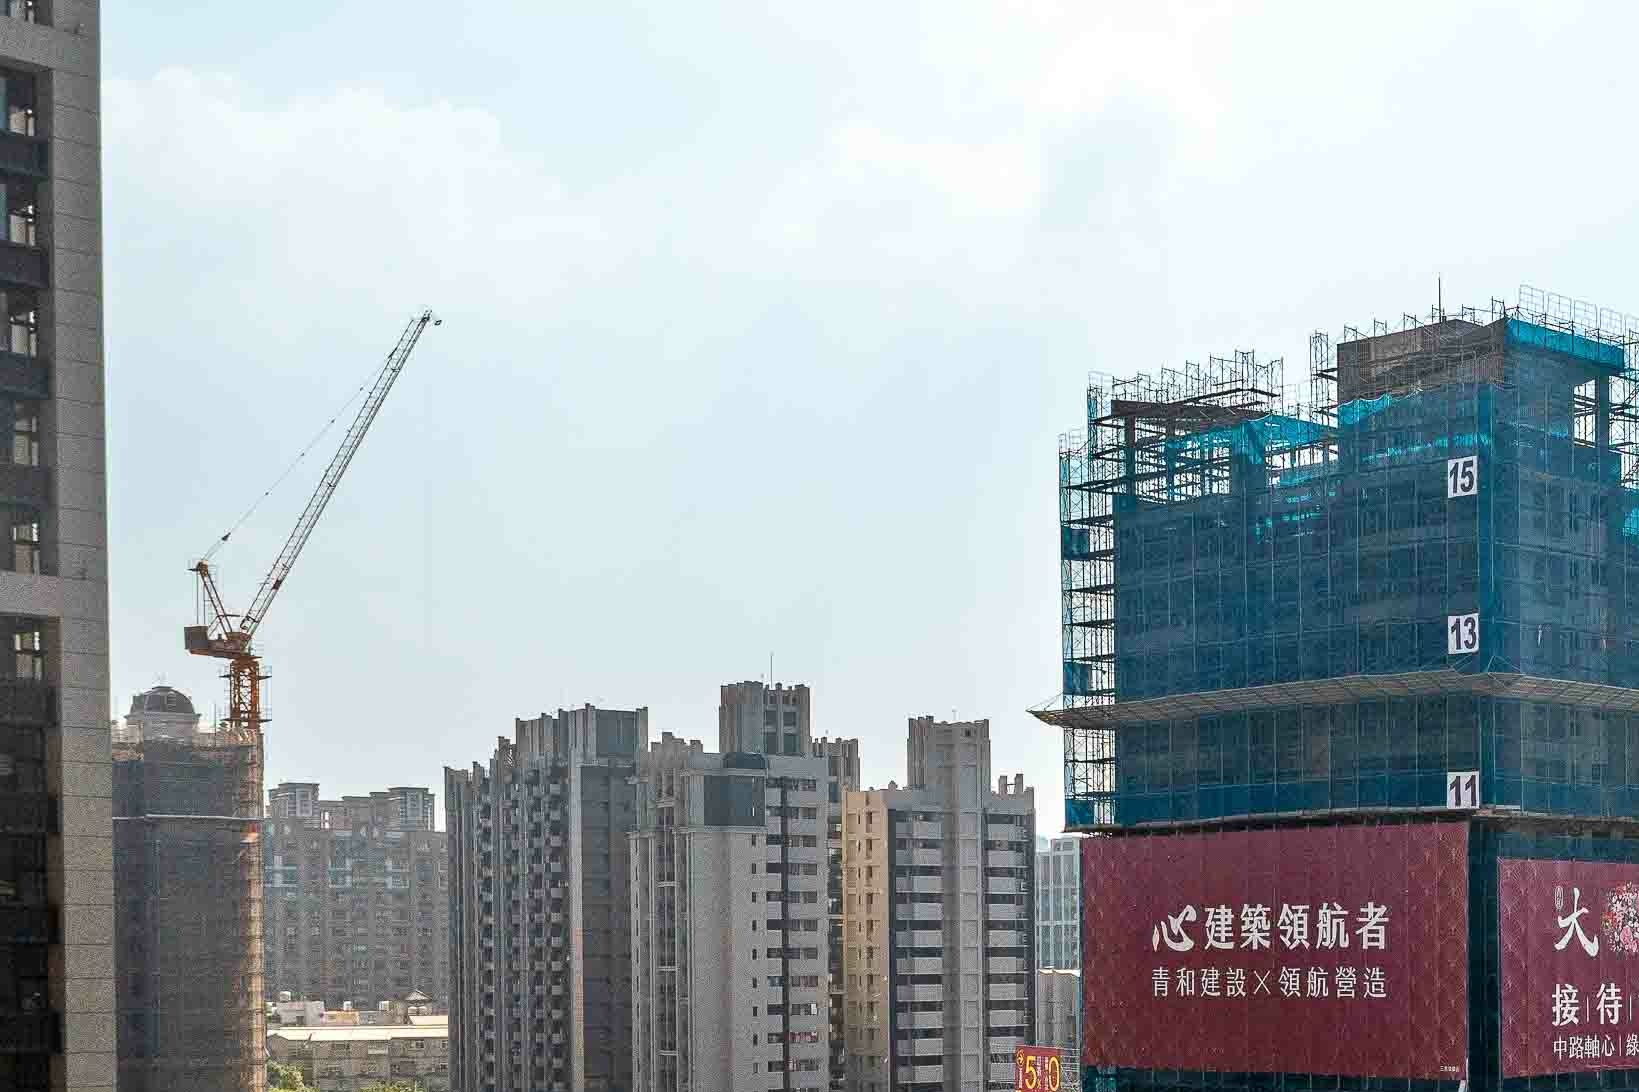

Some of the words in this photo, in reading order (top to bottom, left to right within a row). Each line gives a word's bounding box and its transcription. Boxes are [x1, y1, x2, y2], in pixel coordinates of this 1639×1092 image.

[1450, 461, 1475, 495] 15
[1451, 617, 1478, 652] 13
[1450, 775, 1477, 806] 11
[1151, 902, 1389, 952] 心建築領航者
